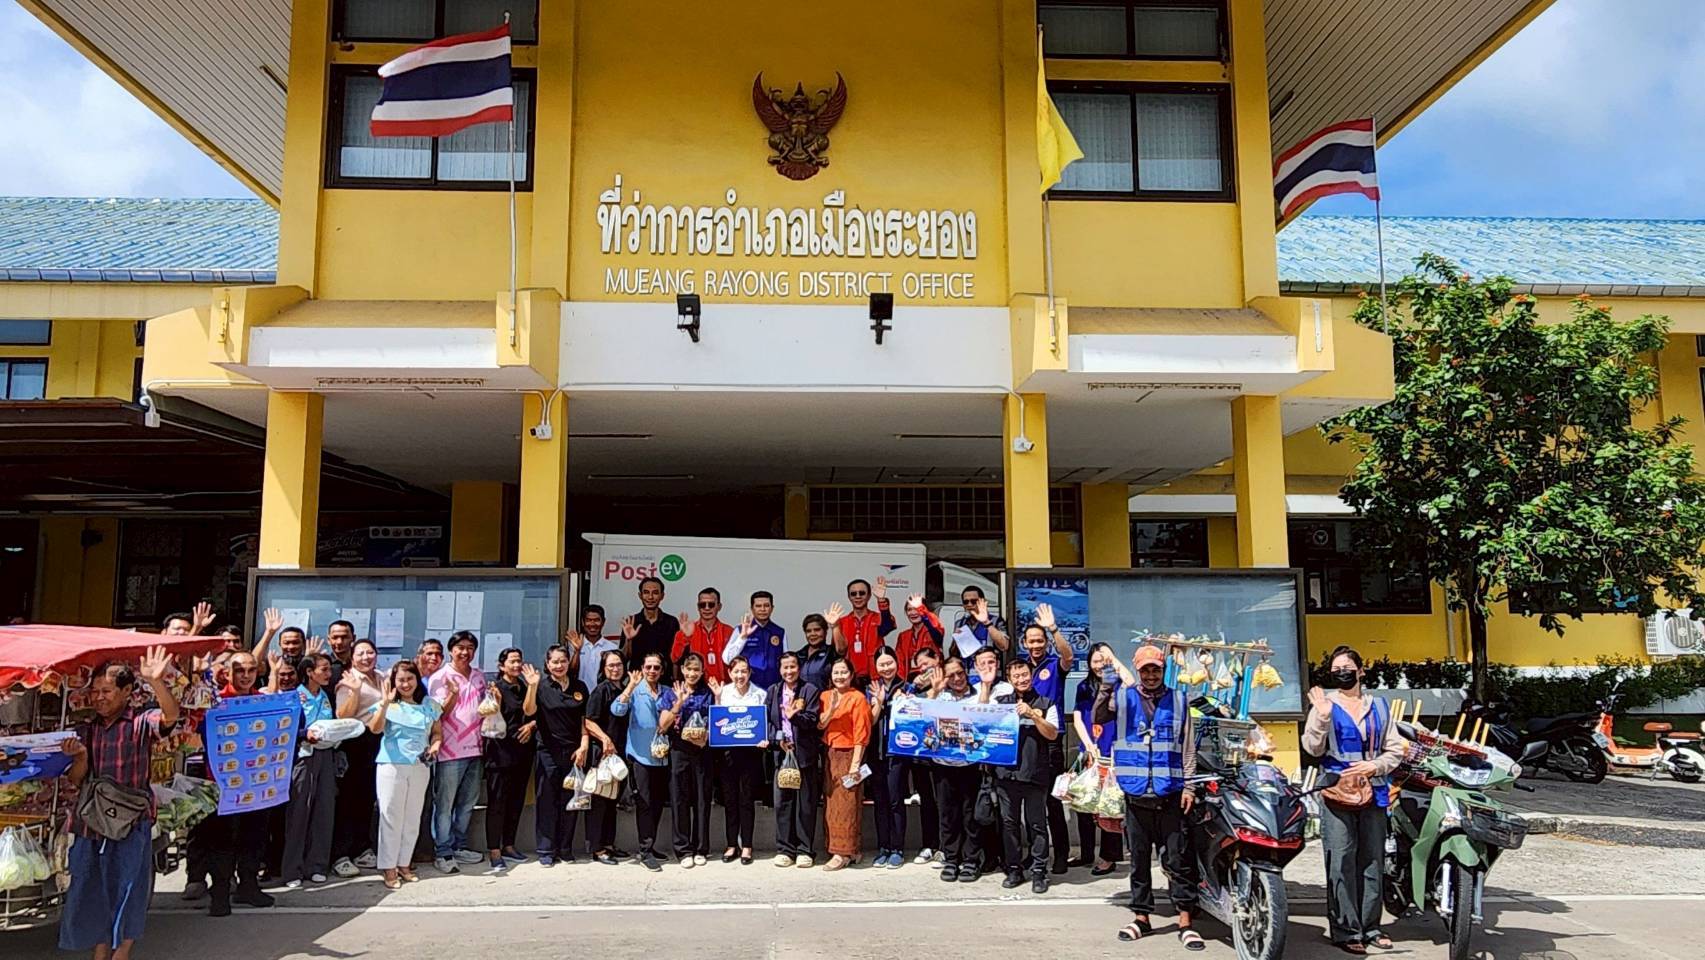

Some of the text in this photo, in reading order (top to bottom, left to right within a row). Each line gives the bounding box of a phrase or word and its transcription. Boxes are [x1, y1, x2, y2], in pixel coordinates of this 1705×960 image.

[597, 174, 978, 259] ที่ว่าการอำเภอเมืองระยอง
[605, 268, 975, 298] MUEANG RAYONG DISTRICT OFFICE
[605, 561, 684, 580] Post ev
